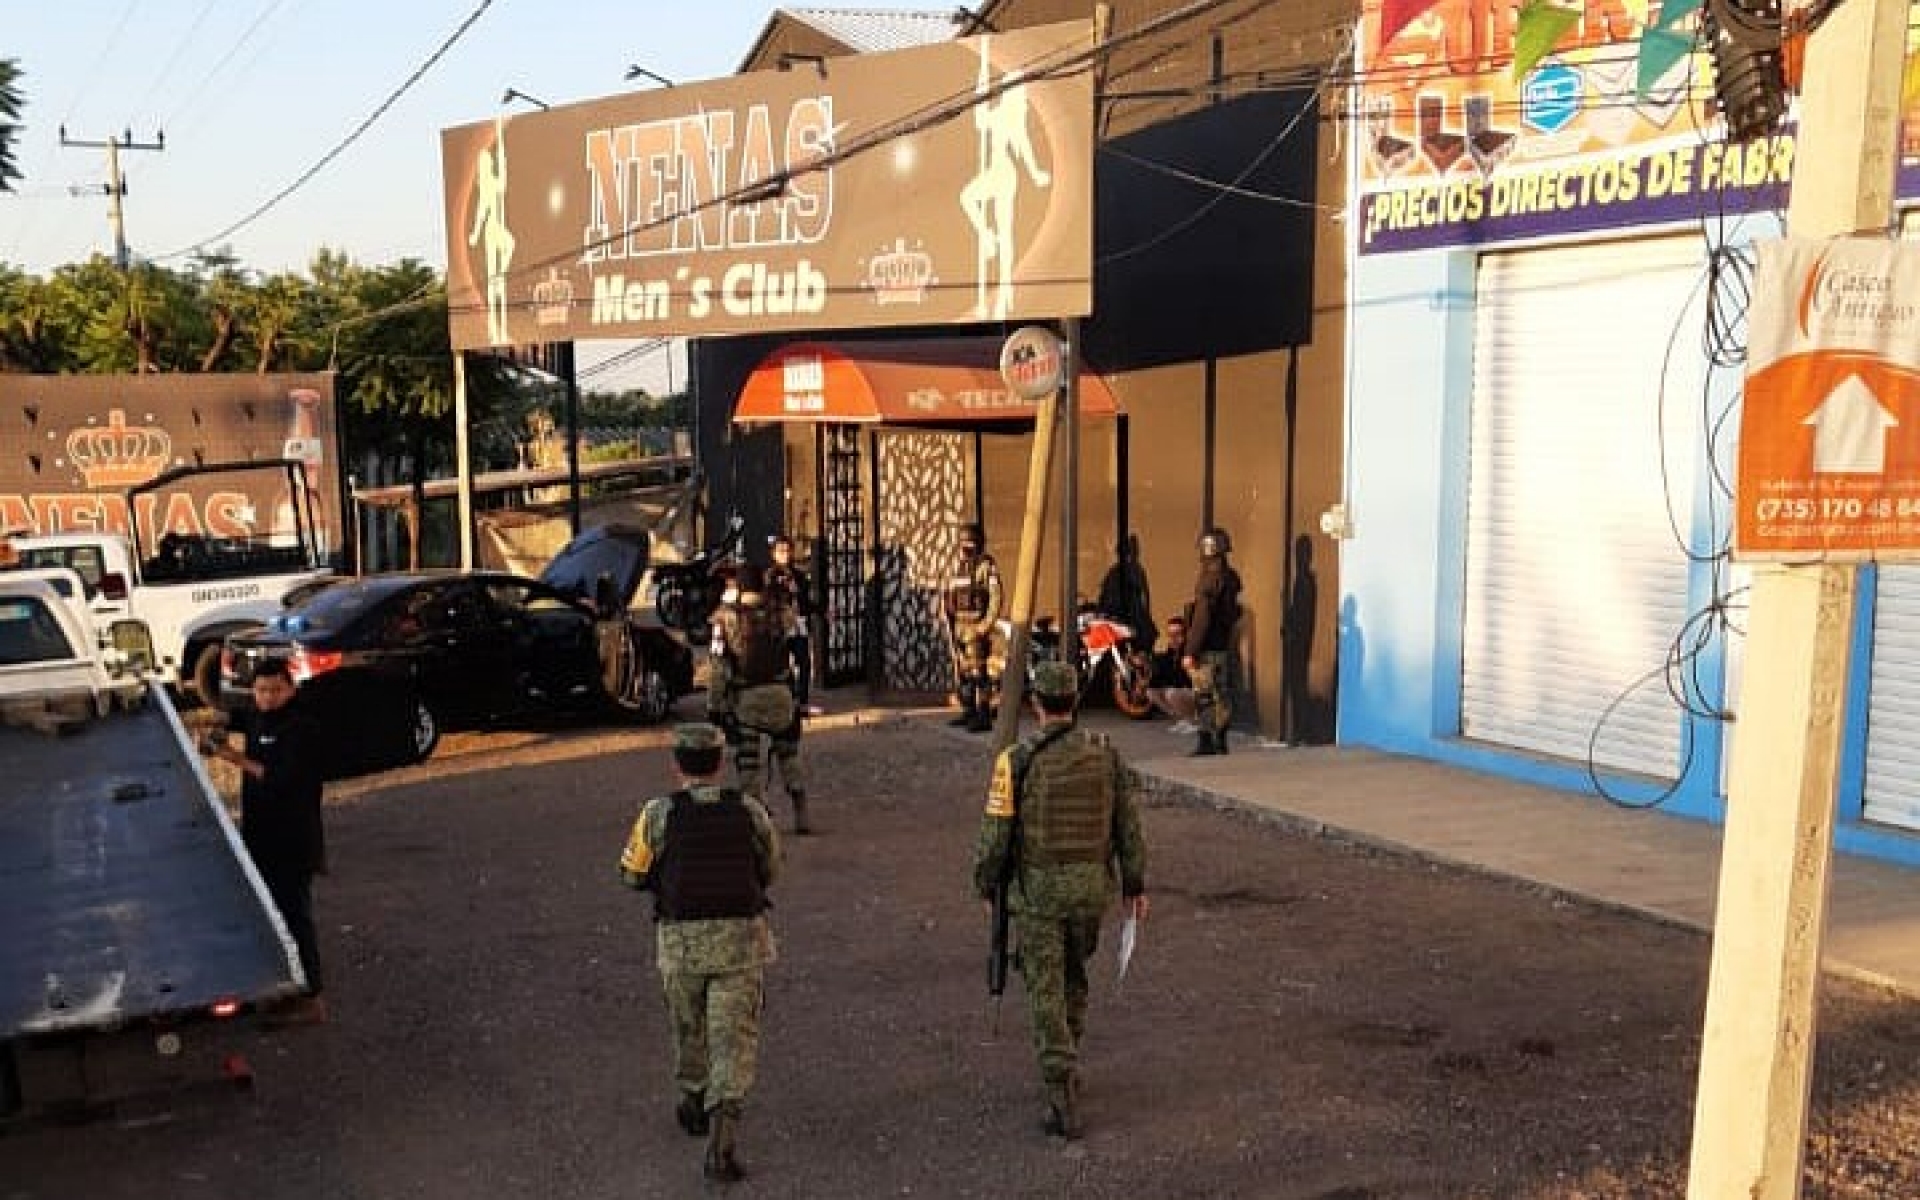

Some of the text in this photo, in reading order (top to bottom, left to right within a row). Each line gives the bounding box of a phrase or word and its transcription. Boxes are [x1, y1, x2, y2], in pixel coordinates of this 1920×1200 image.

[584, 96, 833, 263] NENAS
[1490, 157, 1641, 217] DIRECTOS
[1646, 147, 1695, 198] DE
[722, 260, 828, 316] Club
[1823, 498, 1862, 518] 170
